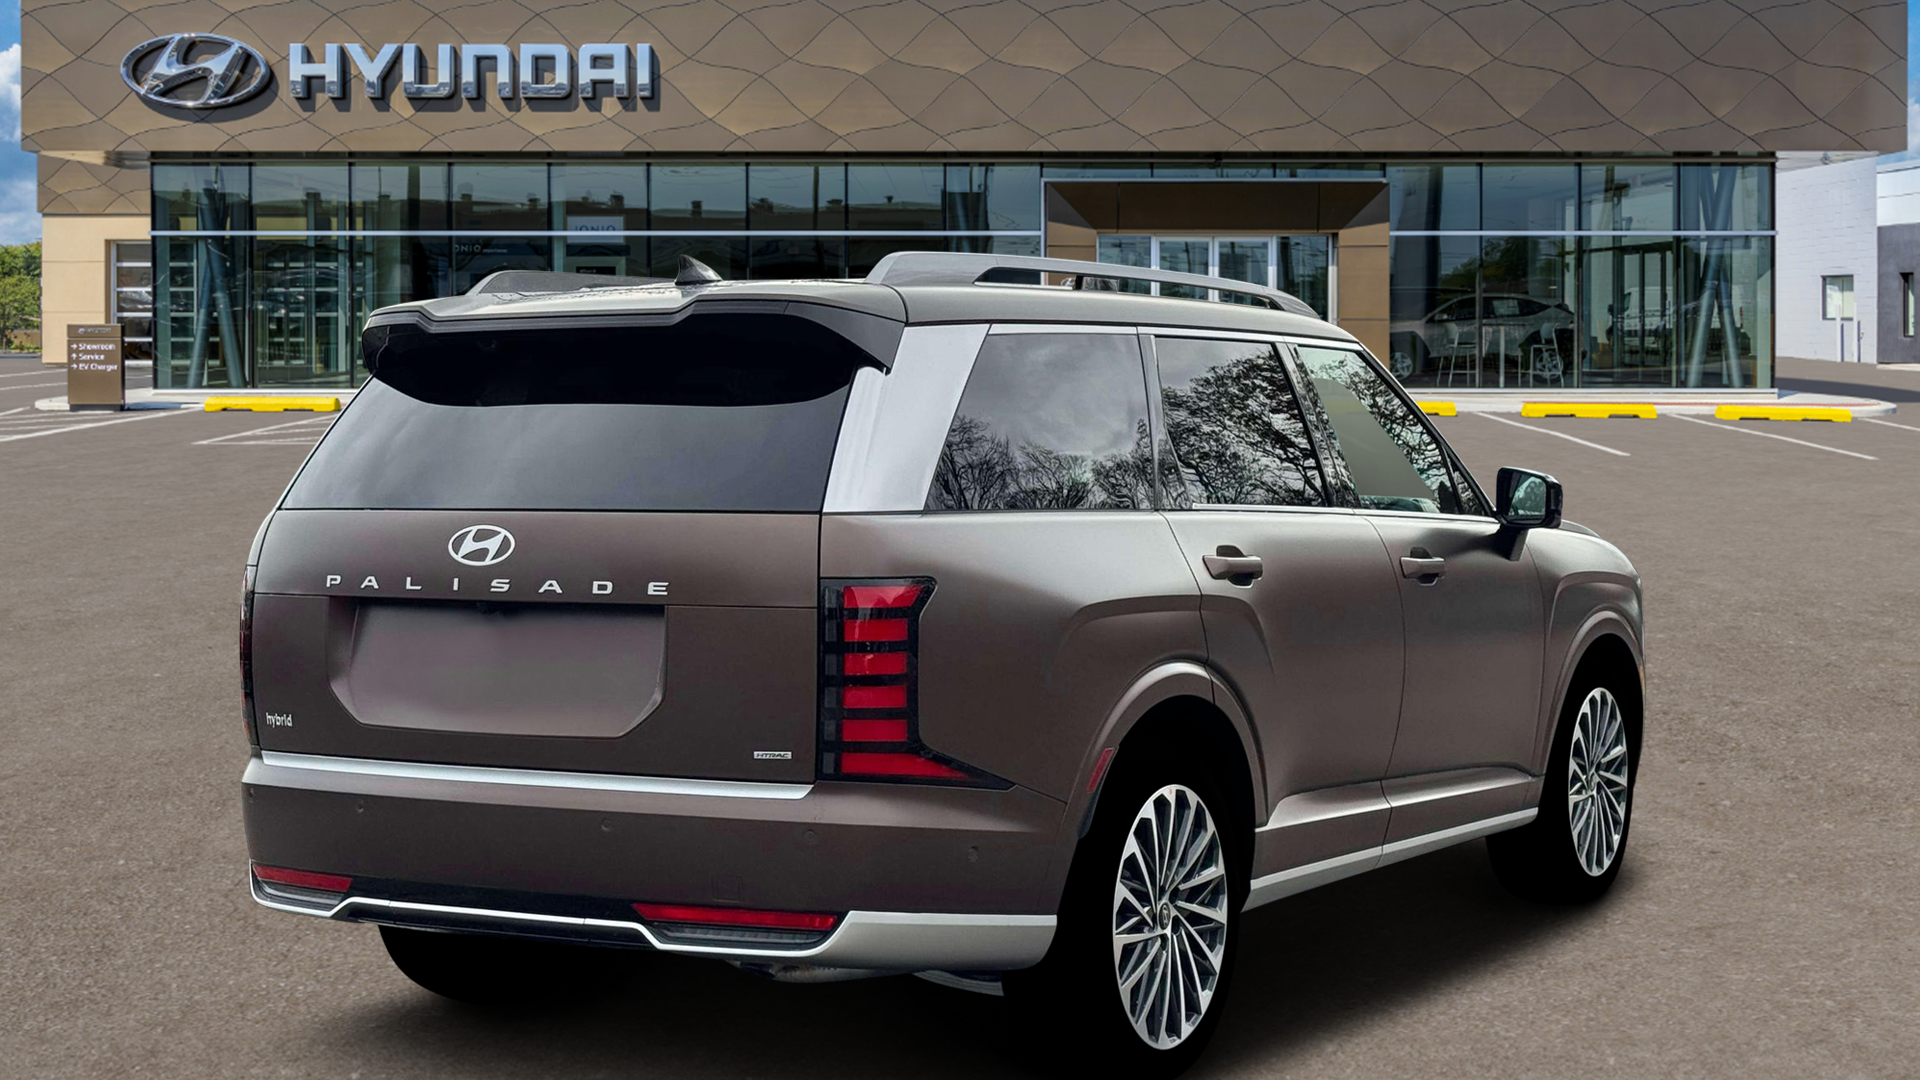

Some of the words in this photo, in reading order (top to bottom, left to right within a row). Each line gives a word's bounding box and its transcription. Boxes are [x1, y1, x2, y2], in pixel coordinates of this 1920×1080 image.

[289, 43, 654, 98] HYUNDAI
[78, 352, 105, 360] Service
[90, 363, 118, 372] Charger
[325, 575, 670, 596] PALISADE
[265, 711, 293, 729] hybrid
